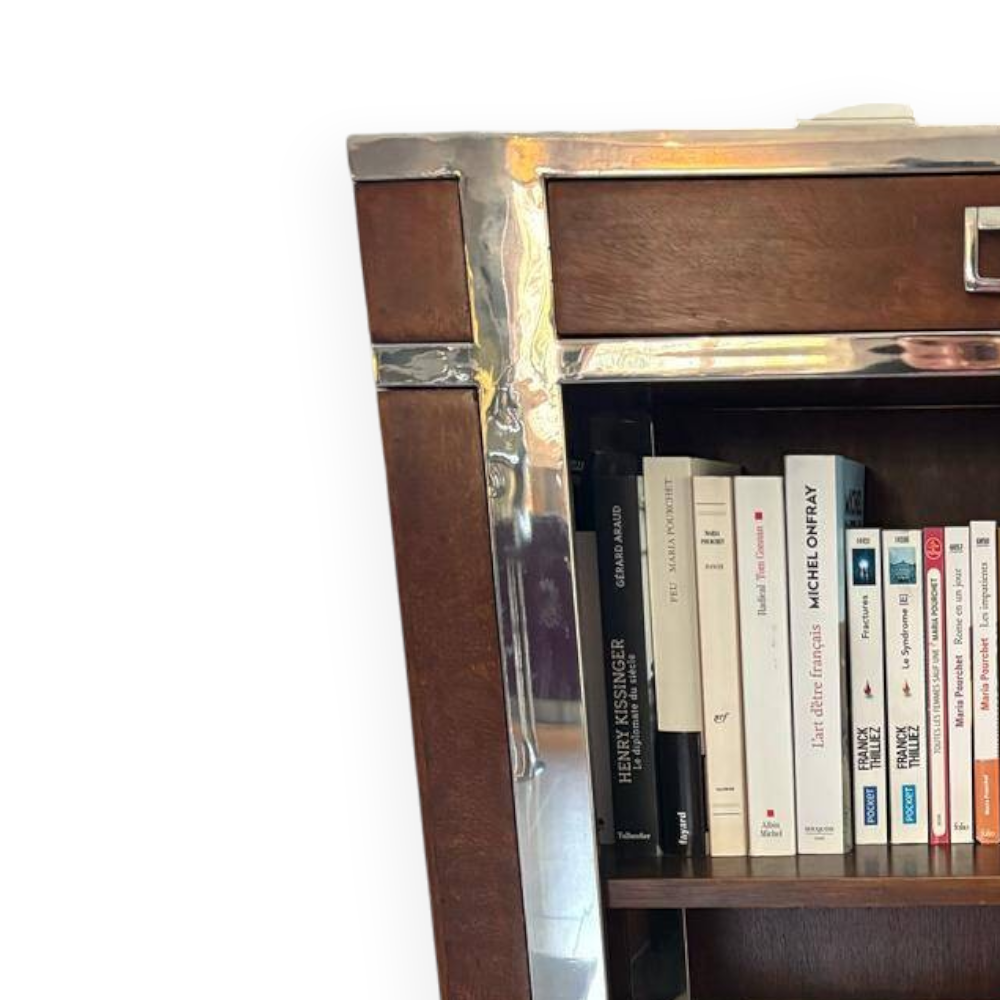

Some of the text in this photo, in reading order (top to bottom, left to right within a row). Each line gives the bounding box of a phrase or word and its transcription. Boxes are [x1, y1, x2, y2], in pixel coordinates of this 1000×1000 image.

[664, 478, 675, 534] POURCHET
[613, 504, 626, 588] GÉRARD ARAUD
[667, 535, 677, 573] MARIA
[755, 554, 765, 579] Tom
[805, 484, 821, 609] MICHEL ONFRAY
[757, 579, 767, 617] Radical
[953, 568, 965, 592] jour
[979, 561, 990, 628] Les impatients
[861, 594, 870, 639] Fractures
[900, 607, 911, 656] Syndrome
[930, 577, 939, 641] MARIA POURCHET
[955, 620, 964, 646] Rome
[902, 657, 910, 670] Le
[979, 637, 989, 711] Maria Pourchet
[809, 624, 824, 749] L'art d'être français
[953, 654, 964, 728] Maria Pourchet
[611, 637, 634, 785] HENRY KISSINGER
[629, 652, 643, 771] Le diplomate du siècle
[858, 726, 869, 771] FRANCK
[870, 726, 881, 771] THILLIEZ
[897, 727, 907, 770] FRANCK
[908, 725, 920, 768] THILLIEZ
[866, 787, 876, 824] POCKET
[905, 786, 915, 823] POCKET
[677, 811, 688, 847] fayard
